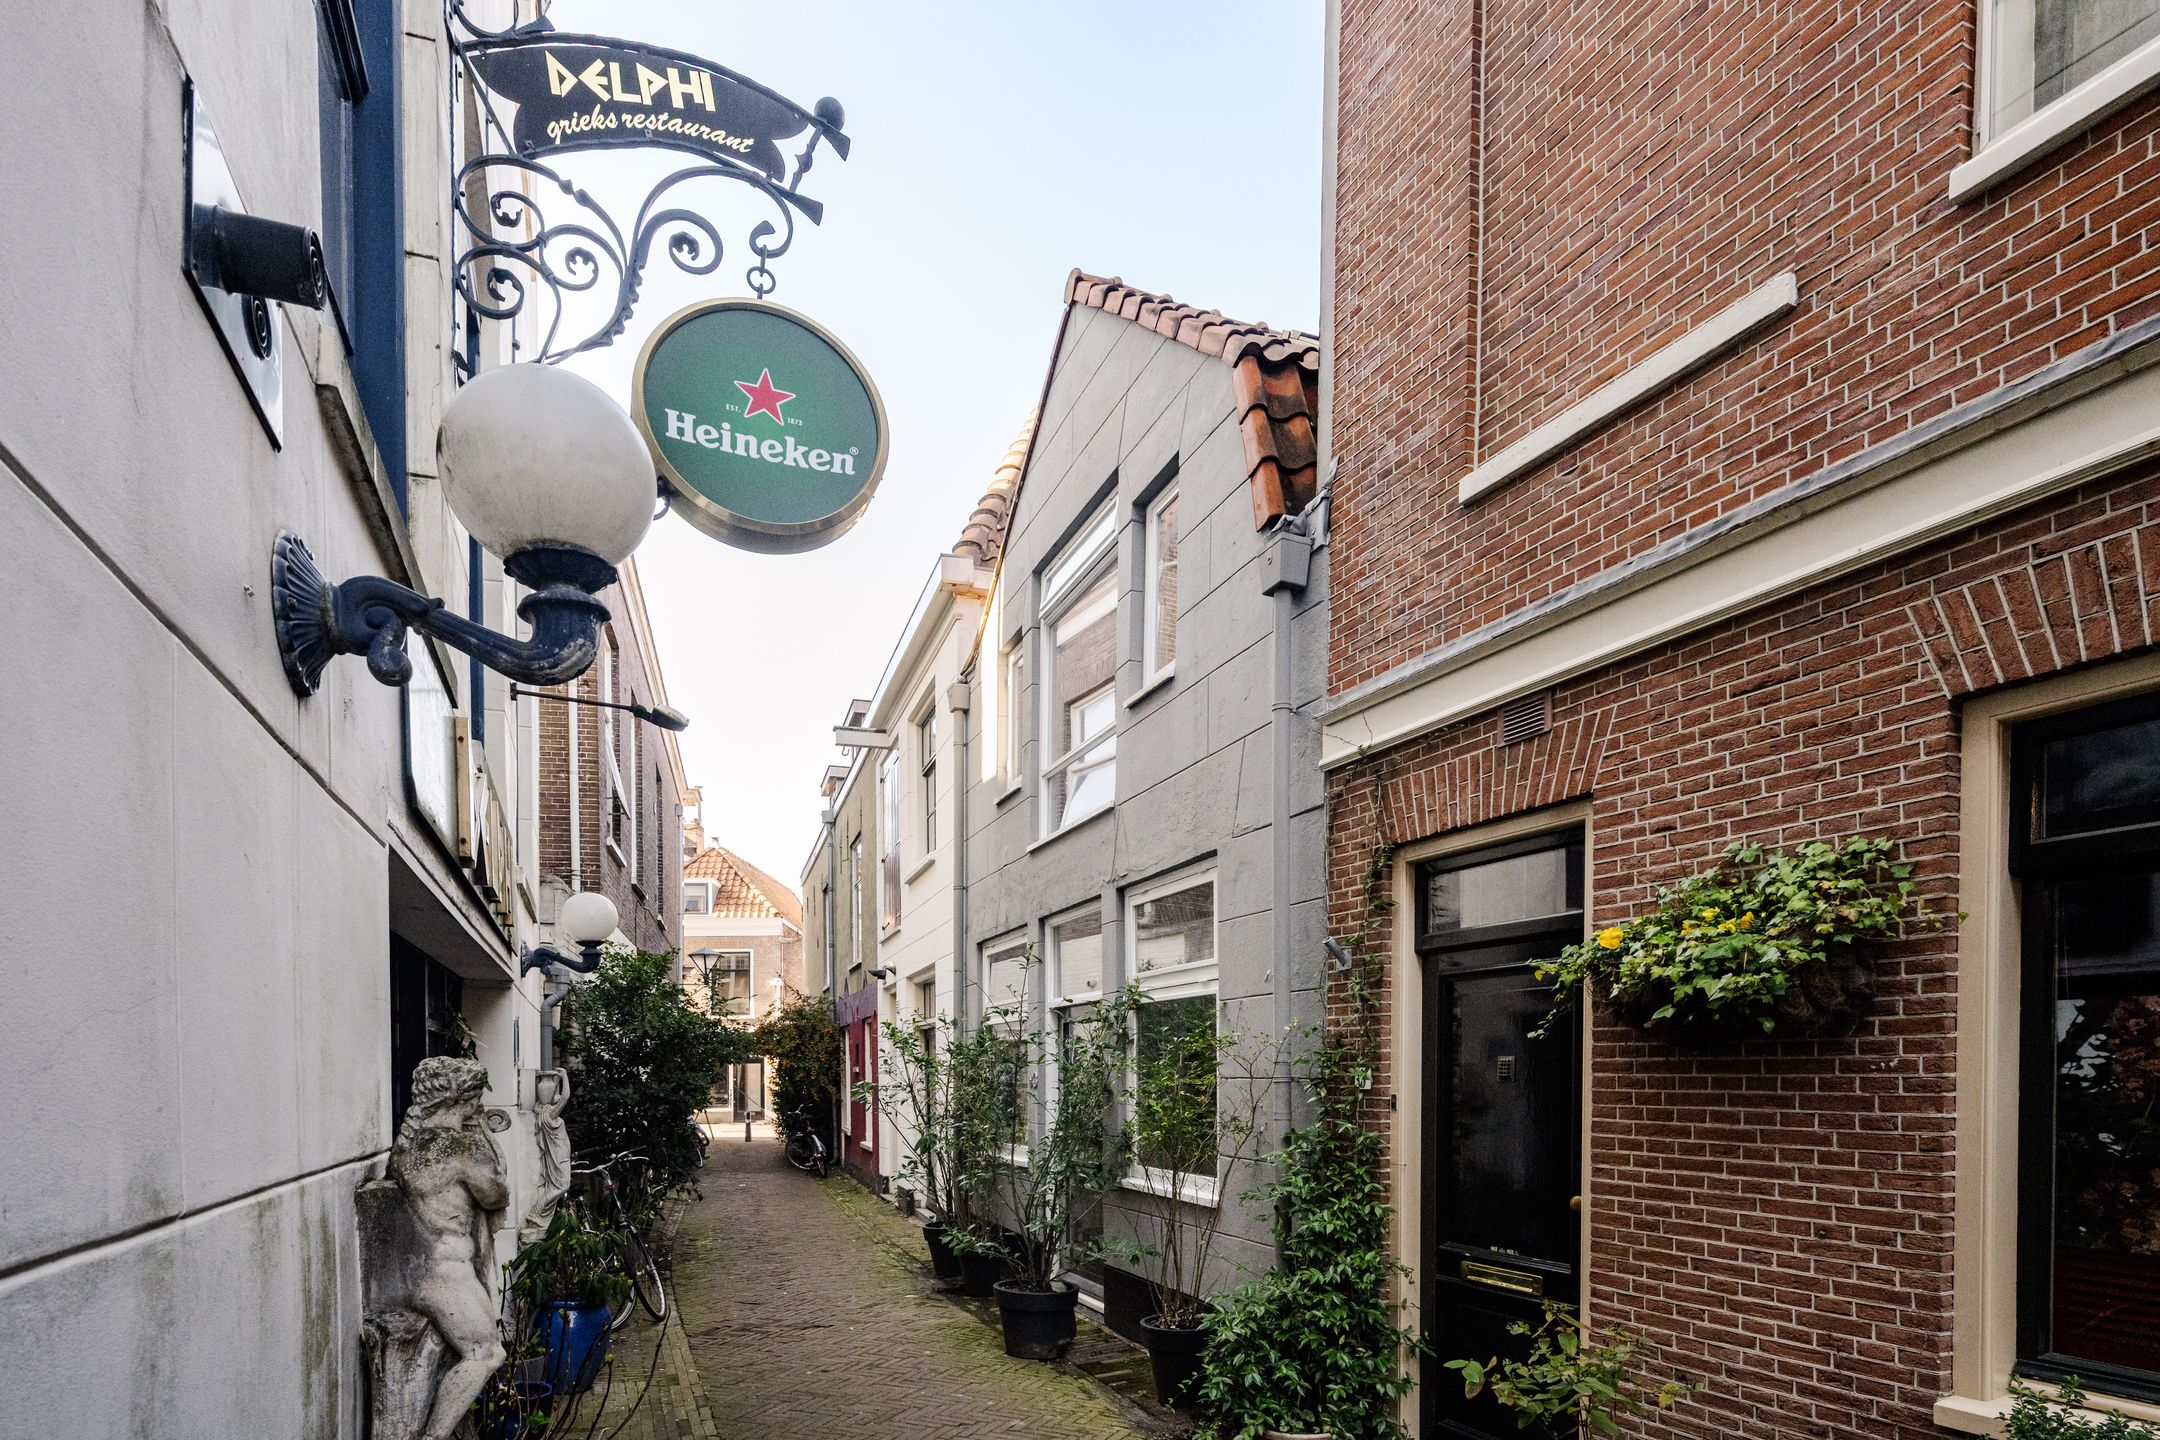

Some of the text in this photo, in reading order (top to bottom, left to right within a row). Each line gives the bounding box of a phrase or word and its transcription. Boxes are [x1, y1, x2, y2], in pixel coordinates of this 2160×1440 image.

[545, 50, 716, 112] DELPHI
[547, 104, 755, 152] grieks restaurant
[725, 403, 803, 426] EST. 1873
